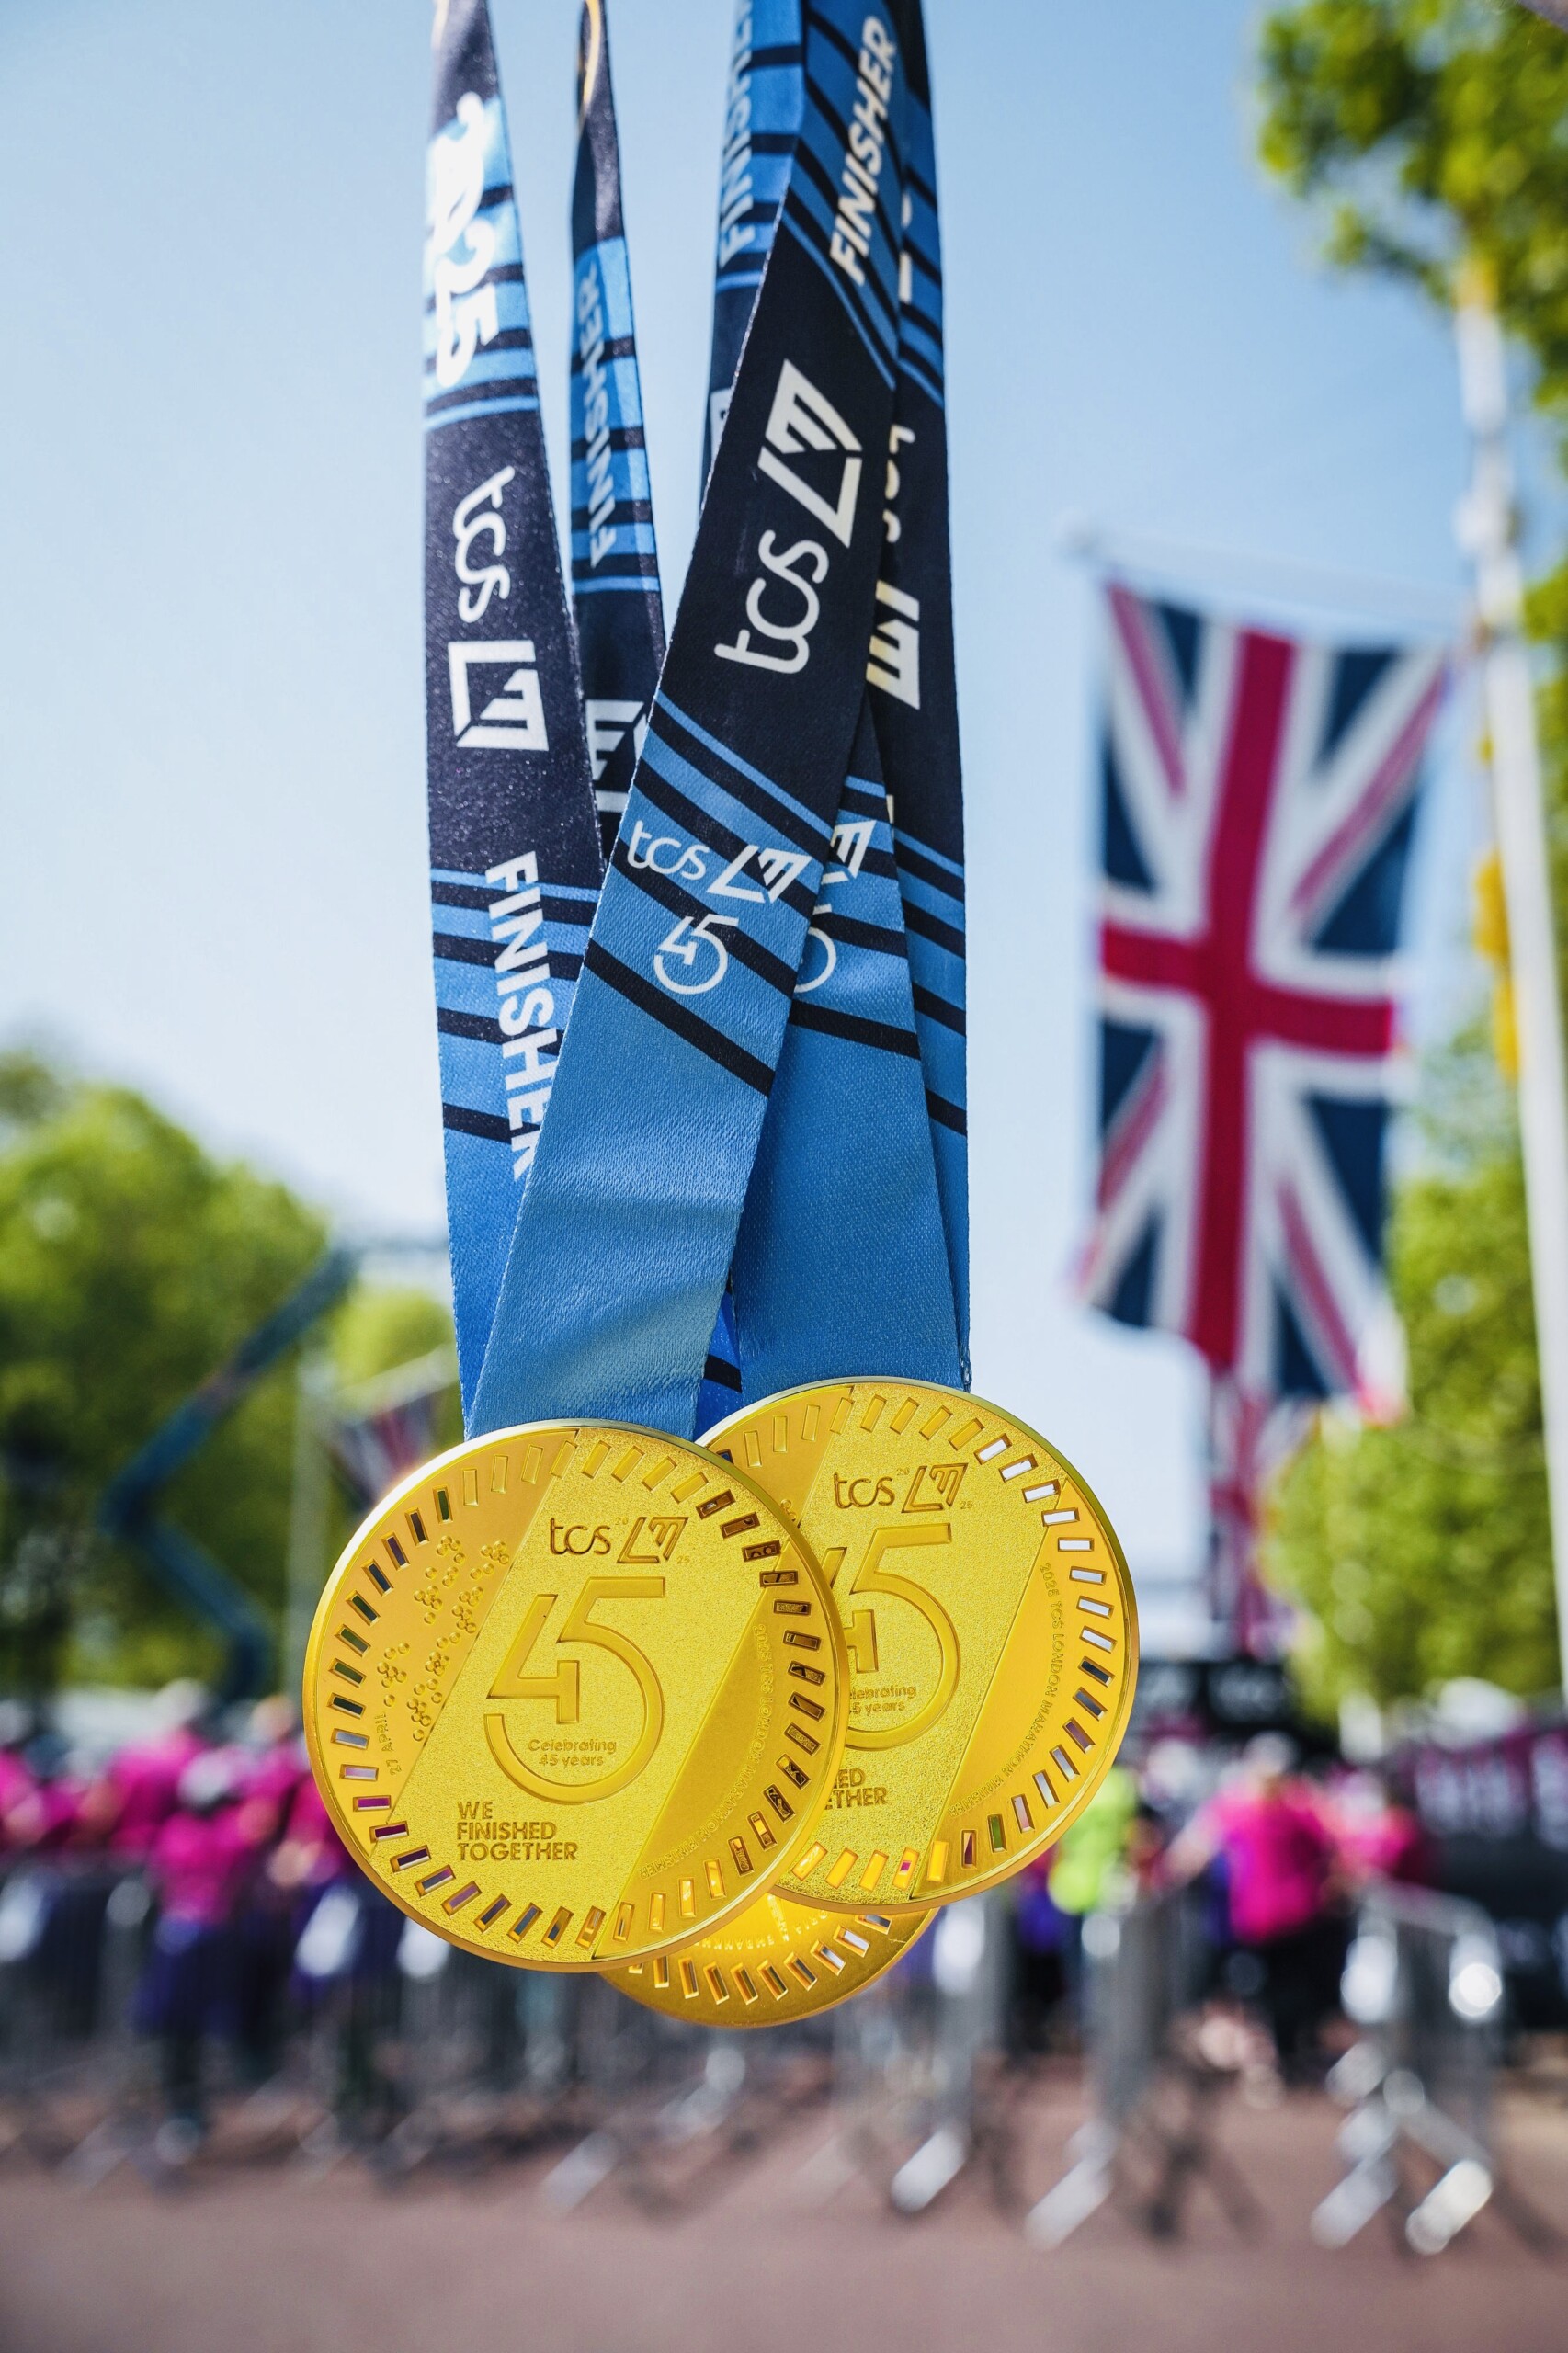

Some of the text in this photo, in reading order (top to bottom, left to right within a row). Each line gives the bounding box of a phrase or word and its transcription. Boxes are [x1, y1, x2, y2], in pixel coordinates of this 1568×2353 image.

[720, 0, 754, 267] FINISHE
[830, 17, 897, 286] FINISHER
[579, 263, 615, 568] FINISHER
[452, 465, 515, 623] tcs
[714, 529, 829, 674] tcs
[626, 819, 710, 881] tcs
[653, 914, 738, 995] 45
[834, 1472, 895, 1509] tcs
[550, 1517, 611, 1555] tcs
[1050, 1603, 1064, 1629] TCS
[1046, 1633, 1065, 1698] LONDON
[484, 1576, 665, 1804] 45
[849, 1685, 916, 1699] lebrating
[849, 1700, 905, 1716] 5 years
[375, 1711, 394, 1751] APRIL
[528, 1738, 617, 1755] Celebrating
[751, 1698, 773, 1763] LONDON
[1001, 1699, 1053, 1778] MARATHON
[539, 1754, 604, 1768] 45 years
[457, 1801, 493, 1820] WE
[697, 1763, 756, 1842] MARATHON
[948, 1776, 1004, 1817] FINISHER
[457, 1821, 557, 1840] FINISHED
[457, 1841, 579, 1861] TOGETHER
[639, 1836, 699, 1879] FINISHER
